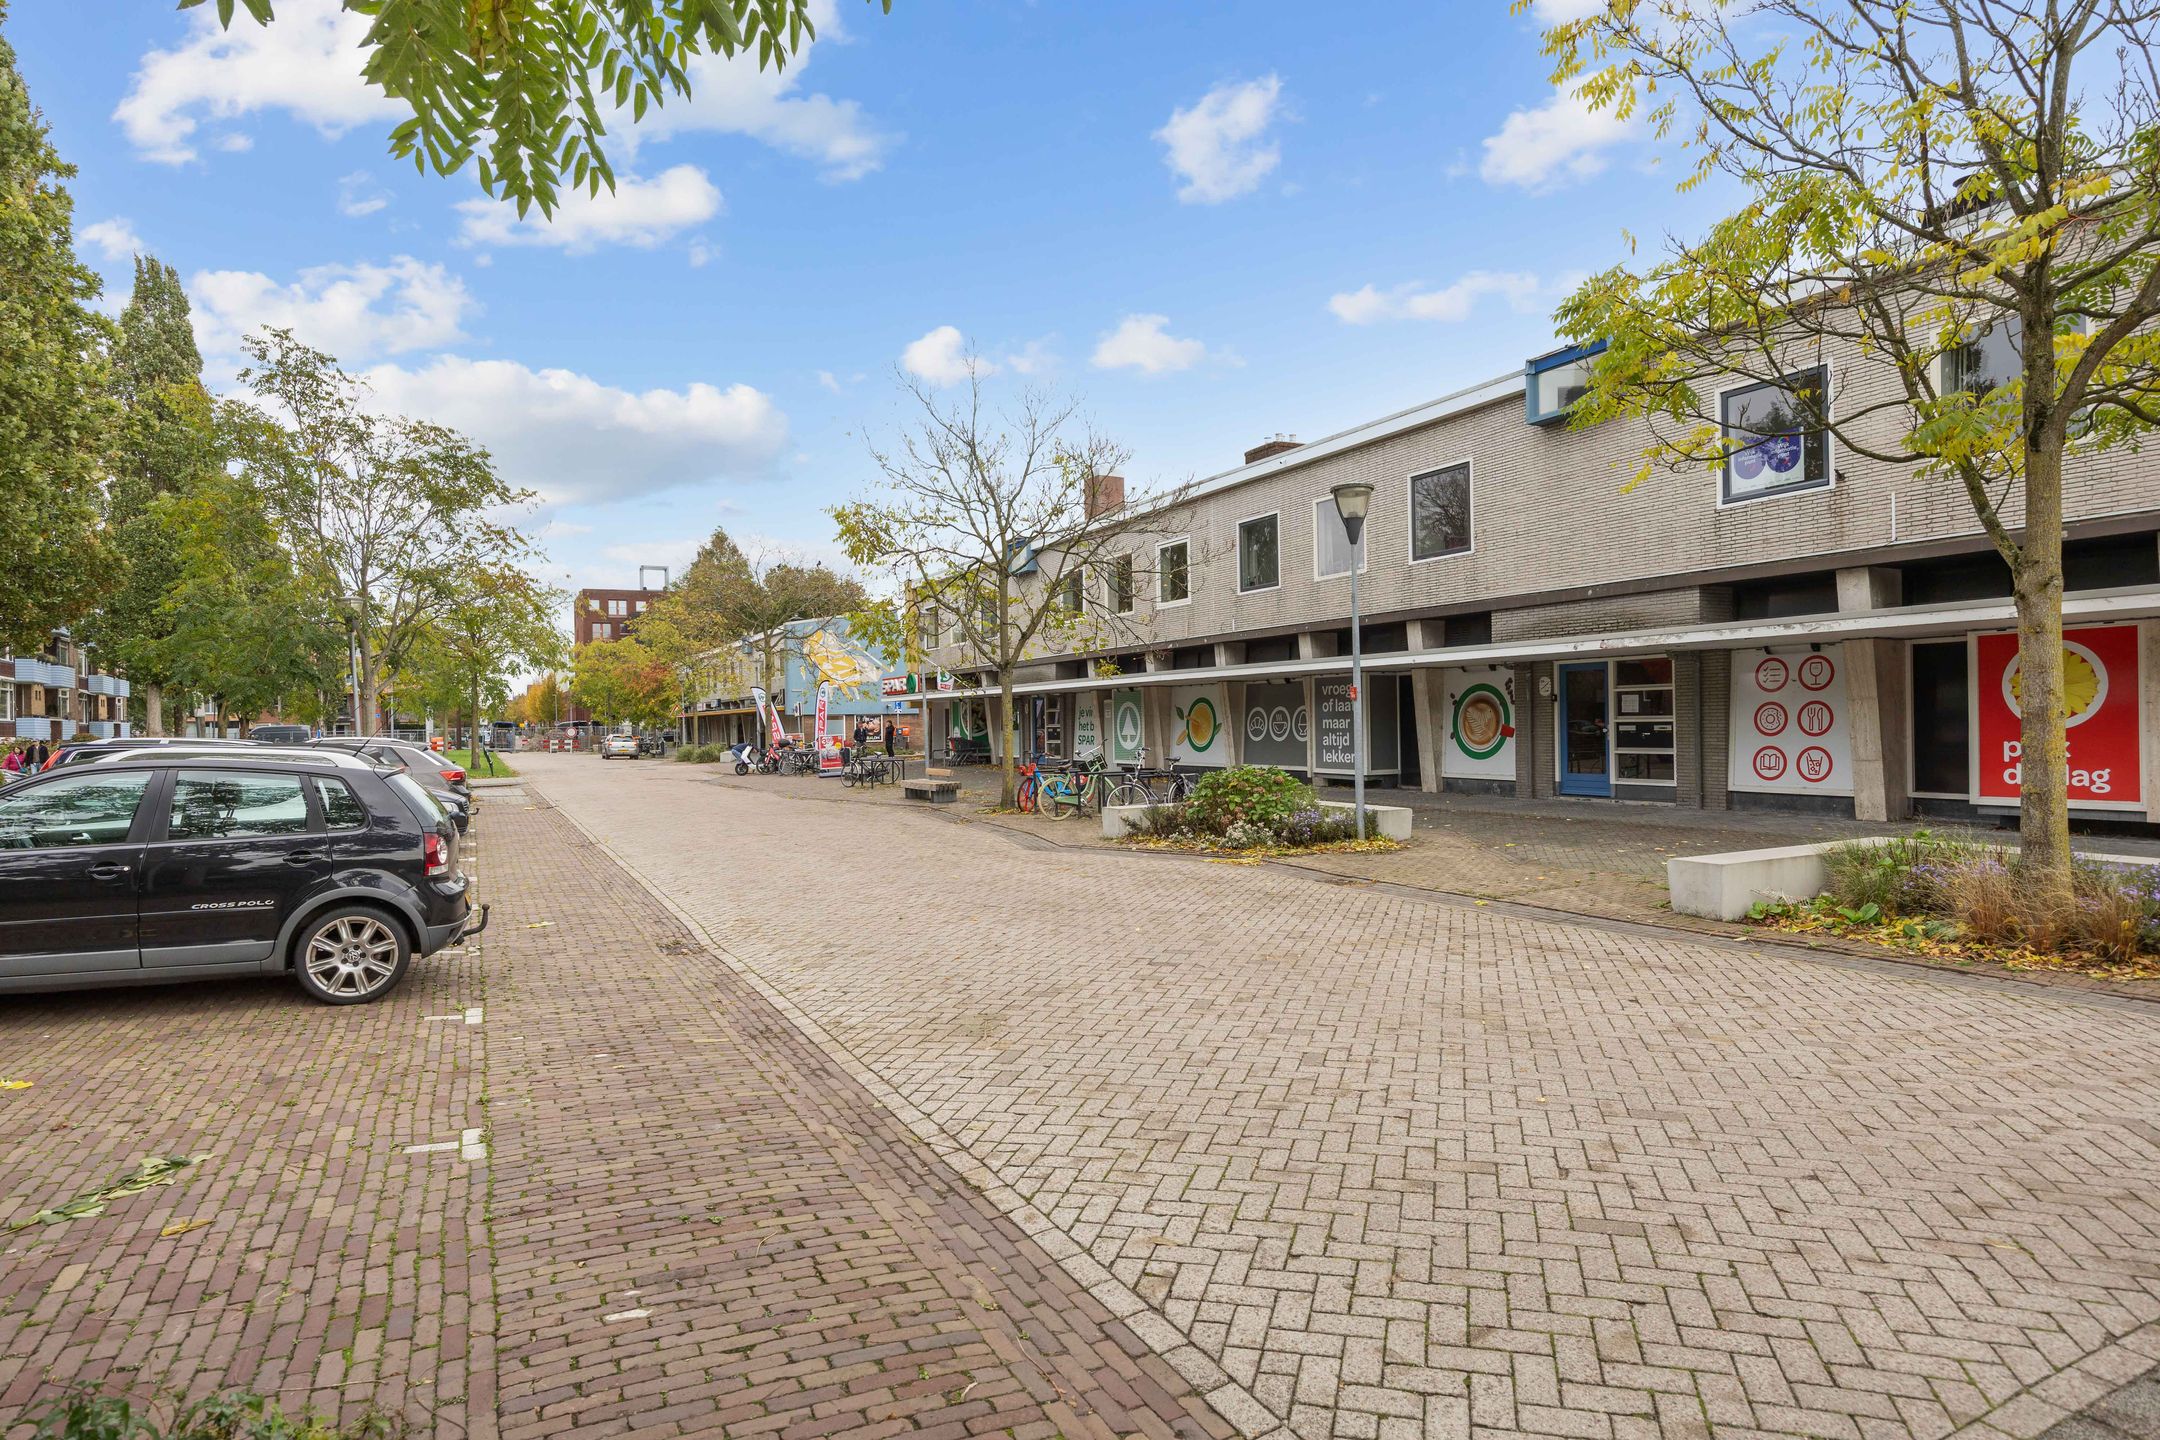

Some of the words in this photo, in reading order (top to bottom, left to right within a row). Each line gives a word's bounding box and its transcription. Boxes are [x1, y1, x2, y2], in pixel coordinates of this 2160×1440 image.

[882, 678, 907, 692] SPAR
[1322, 699, 1334, 712] of
[1078, 720, 1089, 731] het
[1322, 718, 1351, 729] maar
[1078, 734, 1095, 746] SPAR
[1322, 732, 1350, 749] altijd
[1323, 749, 1356, 764] lekker
[191, 901, 236, 910] CROSS
